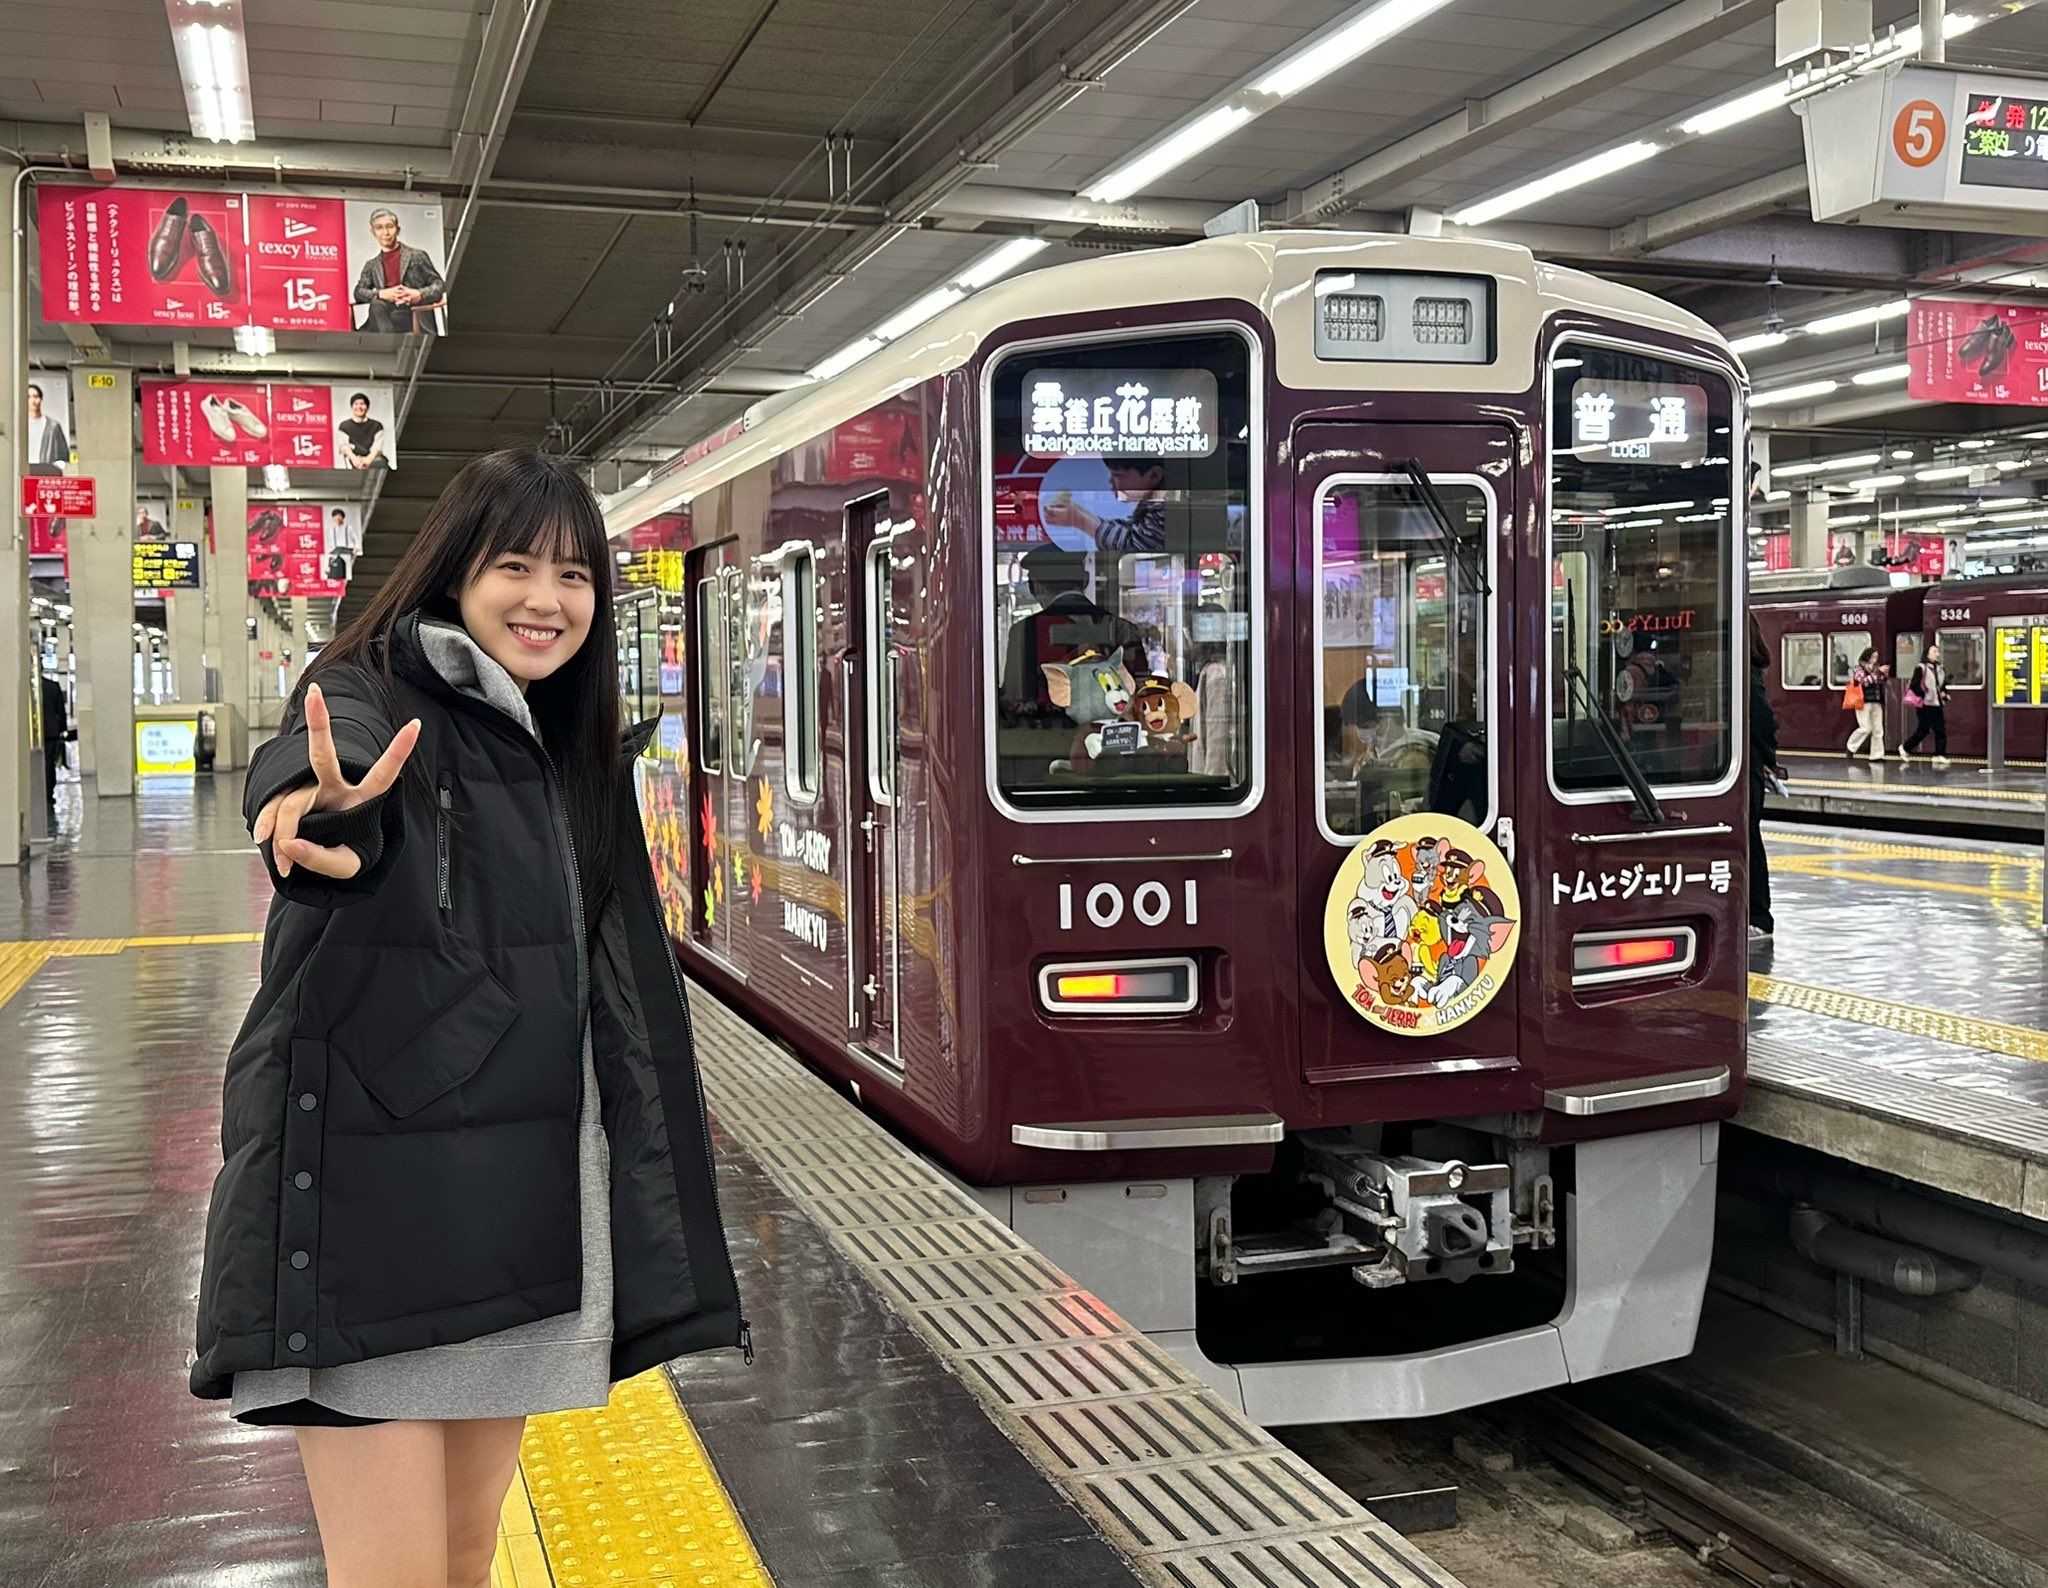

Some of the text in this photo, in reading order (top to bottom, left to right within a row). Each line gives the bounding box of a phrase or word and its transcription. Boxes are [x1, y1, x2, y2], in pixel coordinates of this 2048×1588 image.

[1906, 109, 1934, 159] 5
[258, 240, 338, 259] texcy luxe
[1031, 381, 1202, 435] 雲雀丘花屋敷
[1574, 391, 1690, 443] 普通
[1024, 433, 1209, 456] Hibarigaoka-hanayashiki
[1611, 442, 1650, 458] Local
[39, 489, 61, 500] SOS
[1940, 607, 1971, 621] 5324
[1058, 878, 1198, 930] 1001
[1552, 860, 1732, 905] トムとジェリー号
[783, 900, 828, 953] HANKYU
[1351, 983, 1377, 1012] TOM
[1379, 1005, 1423, 1029] JERRY
[1435, 973, 1495, 1026] HANKYU
